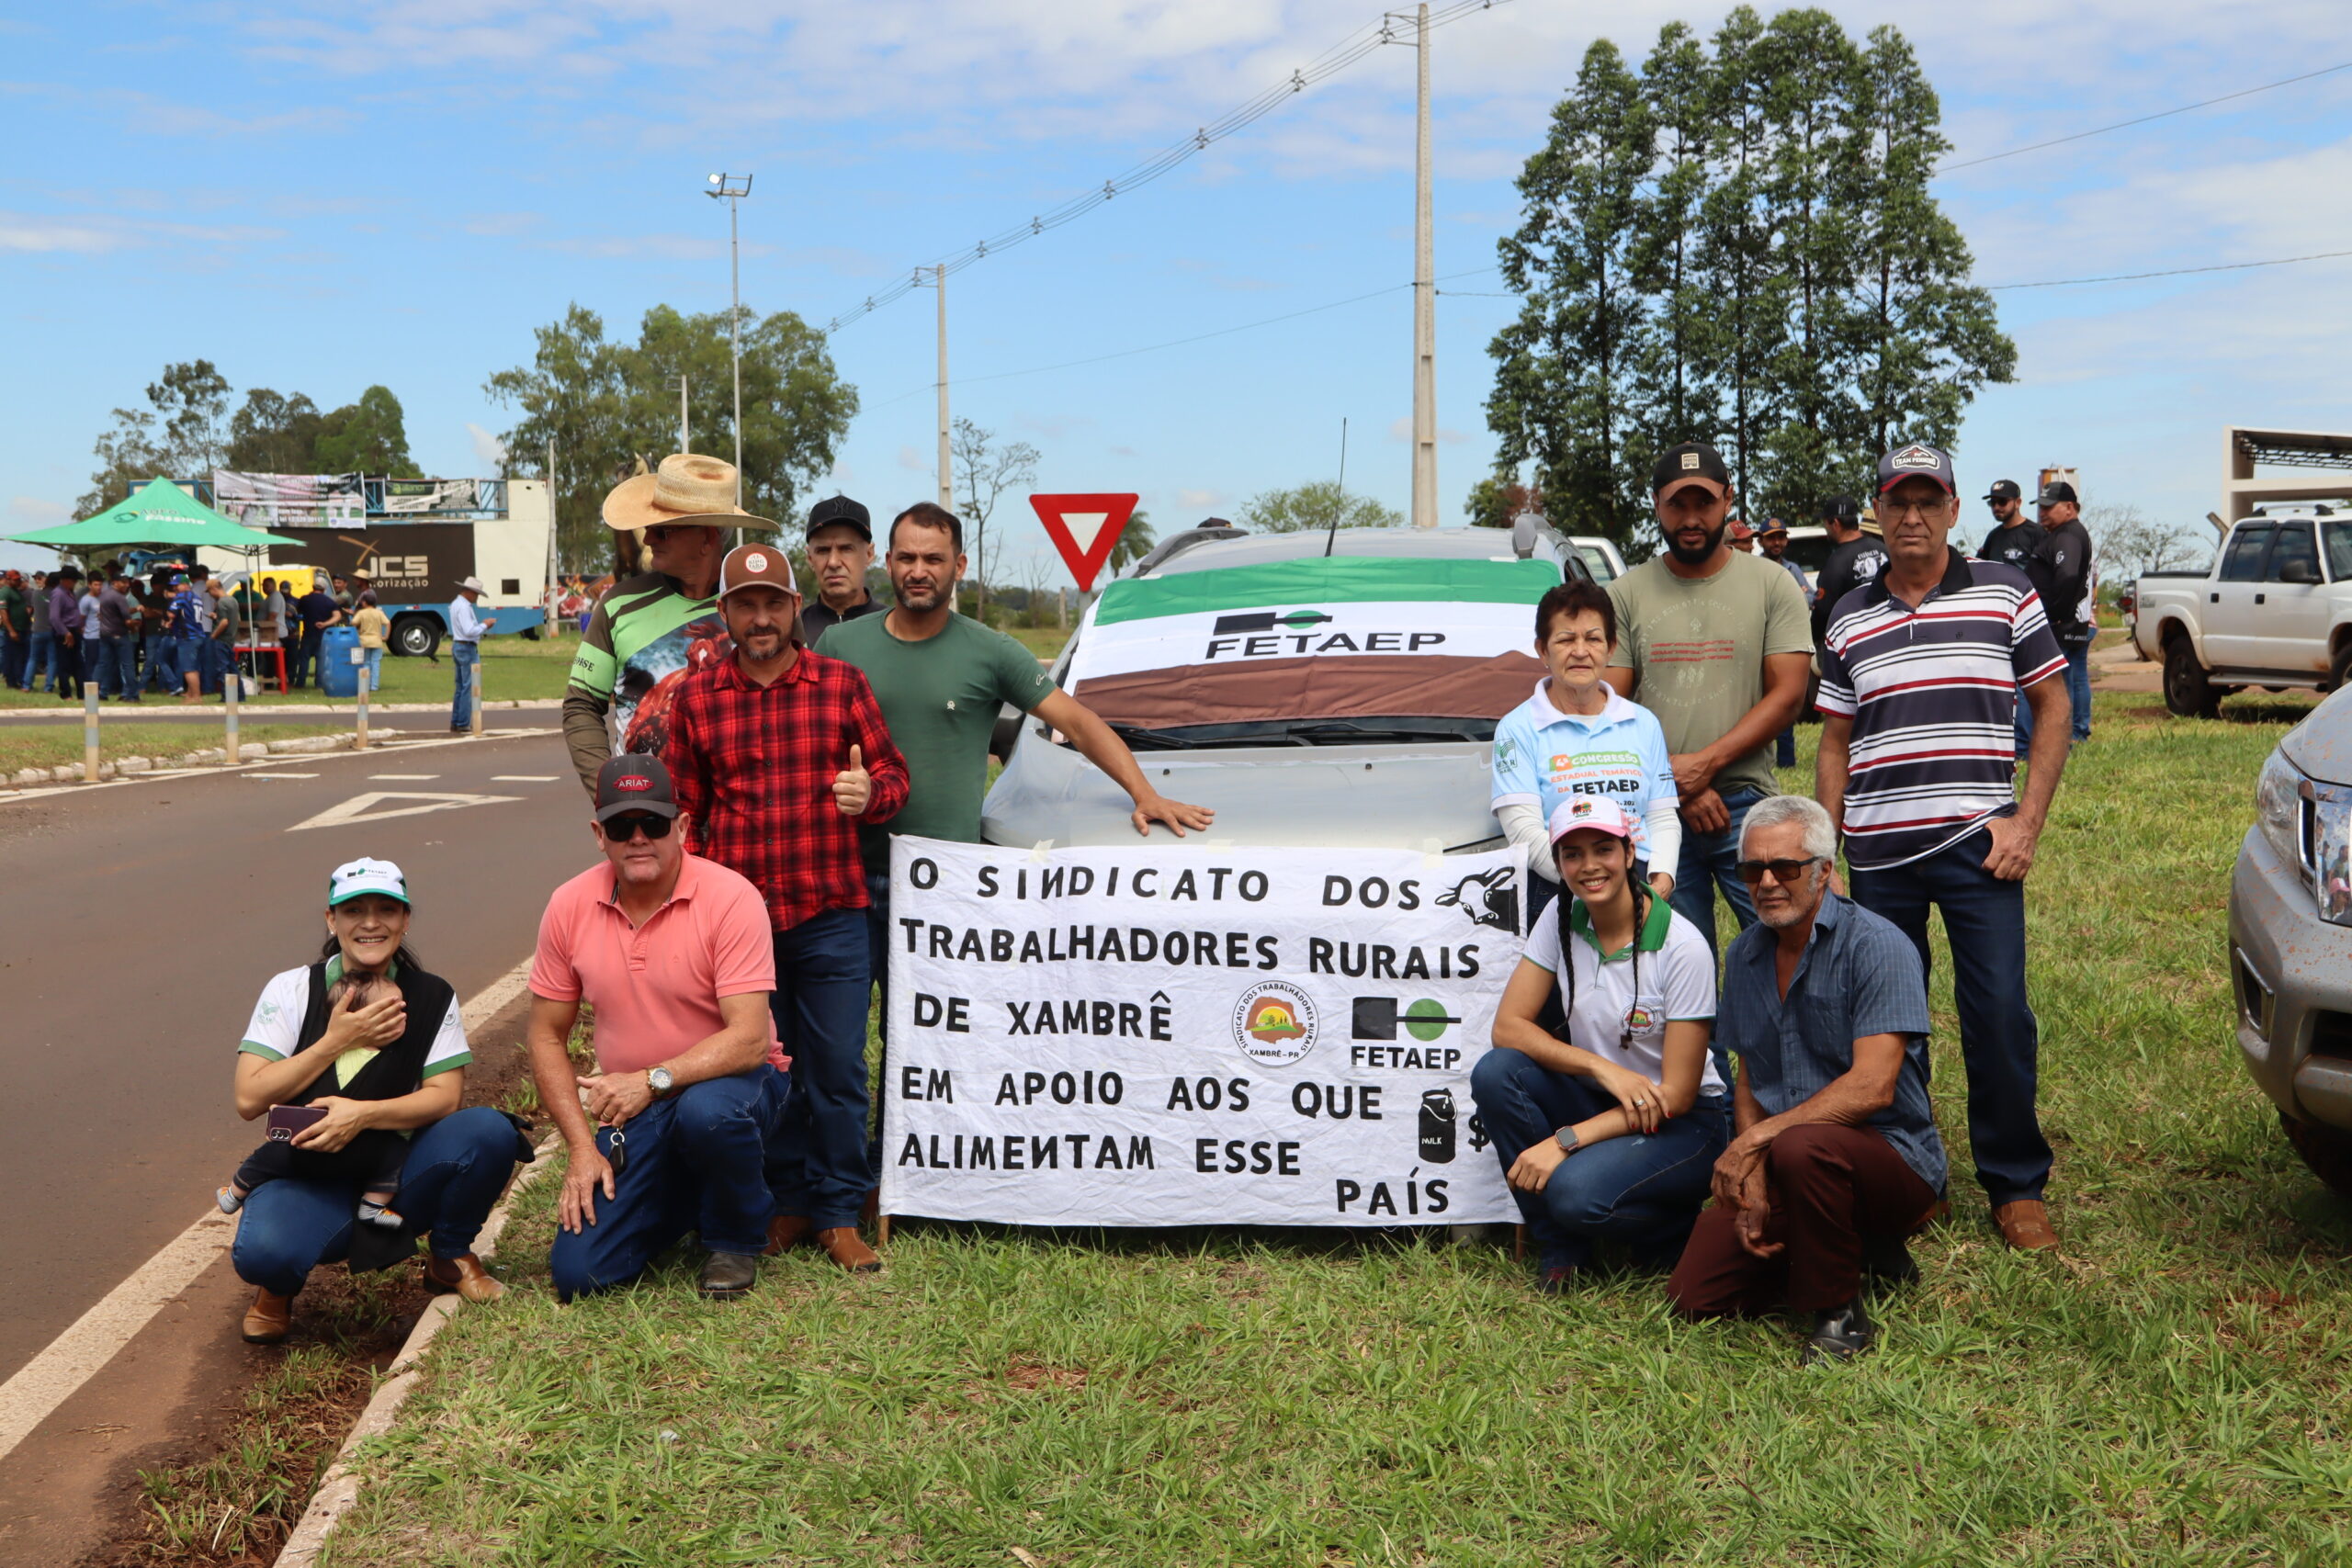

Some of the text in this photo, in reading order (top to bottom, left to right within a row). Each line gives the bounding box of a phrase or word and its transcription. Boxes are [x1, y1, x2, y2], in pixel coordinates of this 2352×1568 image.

[369, 577, 429, 590] orização
[1205, 633, 1446, 660] FETAEP
[1571, 753, 1638, 765] CONGRESSO
[617, 779, 650, 787] ARIAT
[1550, 771, 1599, 784] ESTADUAL
[1572, 779, 1639, 795] FETAEP
[910, 857, 1419, 910] O SINDICATO DOS
[899, 918, 1480, 980] TRABALHADORES RURAIS
[913, 990, 1172, 1042] DE XAMBRÊ
[1236, 983, 1315, 1053] SINDICATO DOS TRABALHADORES RURAIS
[1250, 1049, 1282, 1057] XAMBRÊ
[1351, 1045, 1462, 1069] FETAEP
[901, 1066, 1383, 1121] EM APOIO AOS QUE
[898, 1133, 1301, 1176] ALIMENTAM ESSE
[1336, 1166, 1449, 1216] PAÍS
